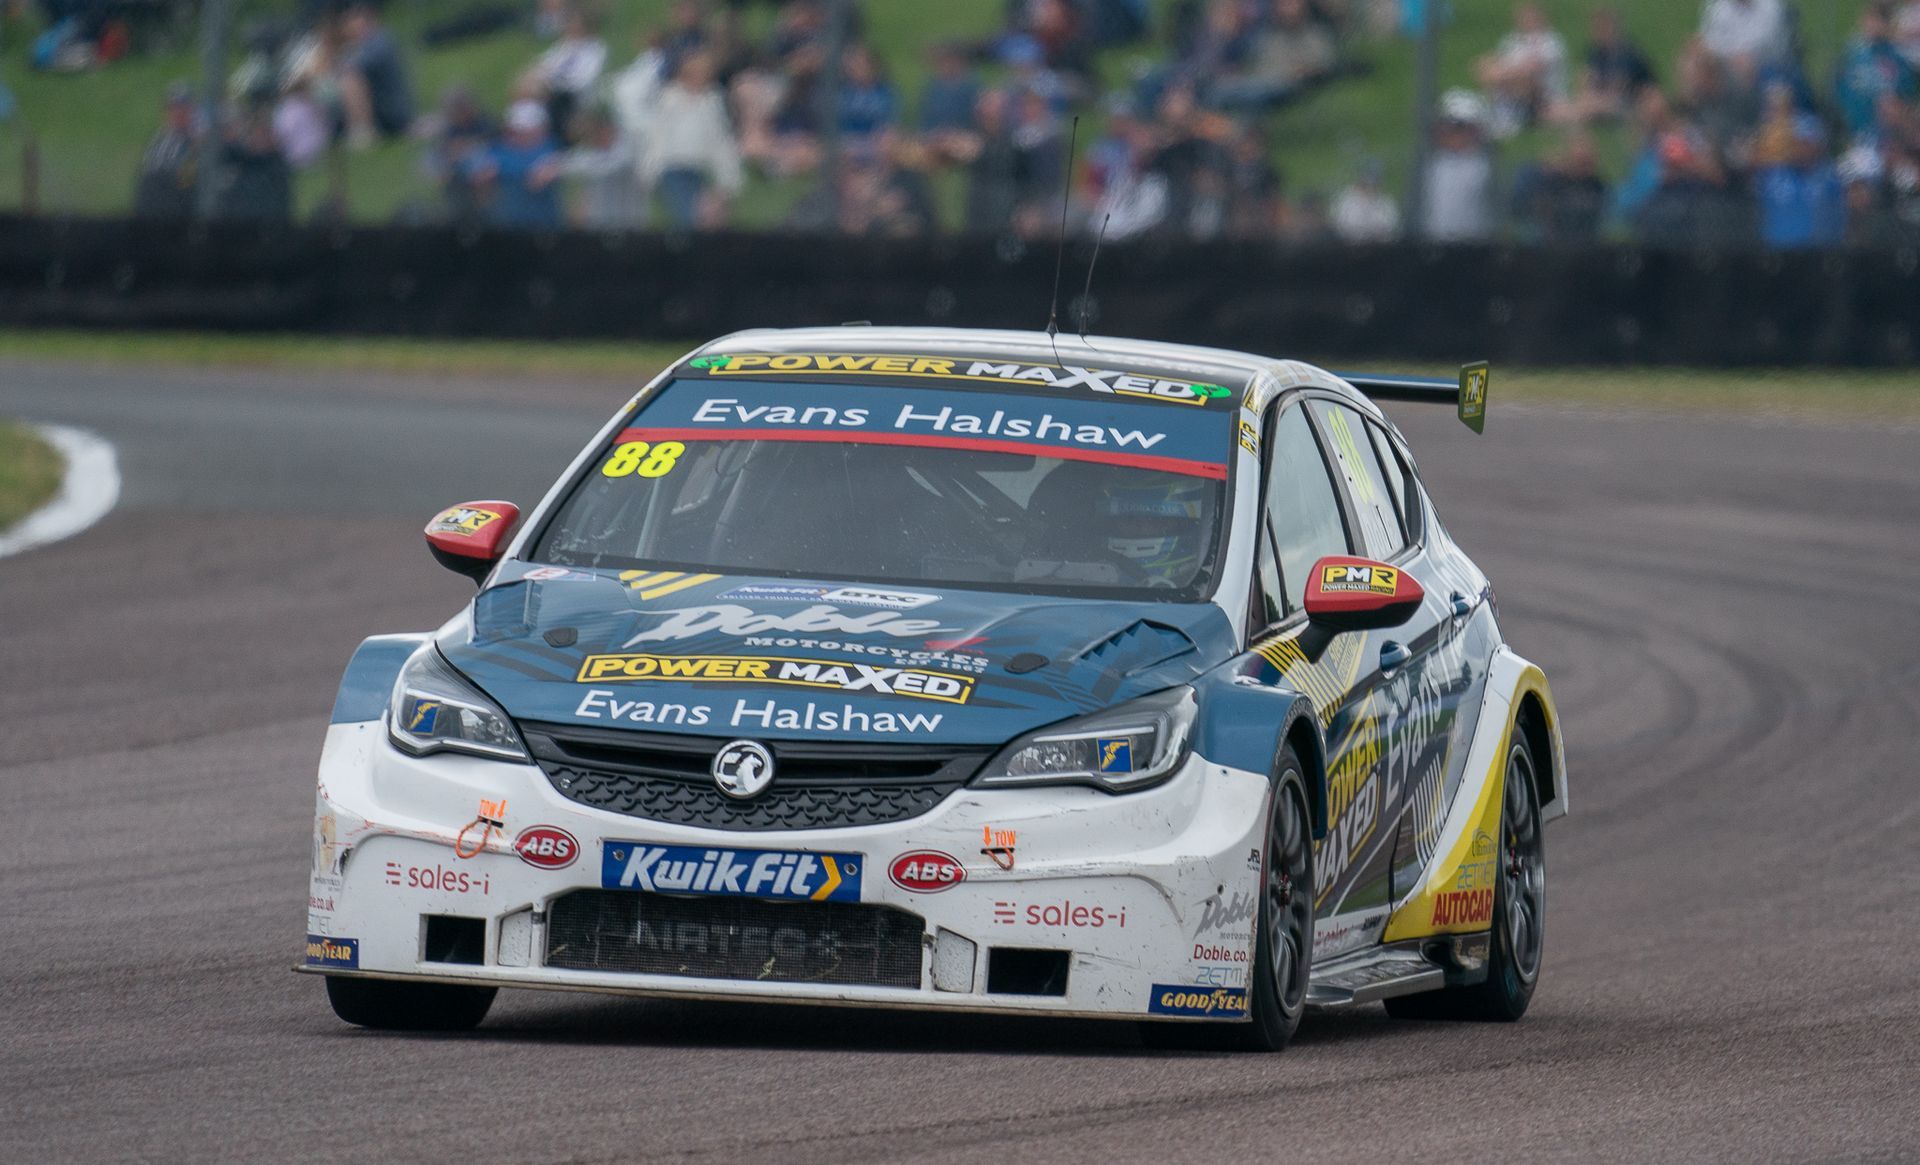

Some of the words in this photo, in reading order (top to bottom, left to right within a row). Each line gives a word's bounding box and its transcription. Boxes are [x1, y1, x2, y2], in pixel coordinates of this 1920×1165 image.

[724, 355, 956, 375] POWER
[965, 361, 1196, 398] MAXED
[691, 398, 869, 428] Evans
[895, 404, 1167, 450] Halshaw
[602, 441, 686, 479] 88
[1325, 566, 1394, 585] PMR
[612, 605, 966, 649] Doble
[743, 636, 989, 668] MOTORCYCLES
[588, 657, 771, 679] POWER
[778, 662, 963, 698] MAXED
[575, 689, 711, 726] Evans
[729, 698, 943, 733] Halshaw
[1328, 714, 1377, 831] OWER
[523, 838, 571, 858] ABS
[995, 830, 1017, 848] TOW
[408, 864, 490, 895] sales-i
[900, 860, 956, 882] ABS
[1026, 901, 1127, 929] sales-i
[1432, 889, 1492, 926] AUTOCAR
